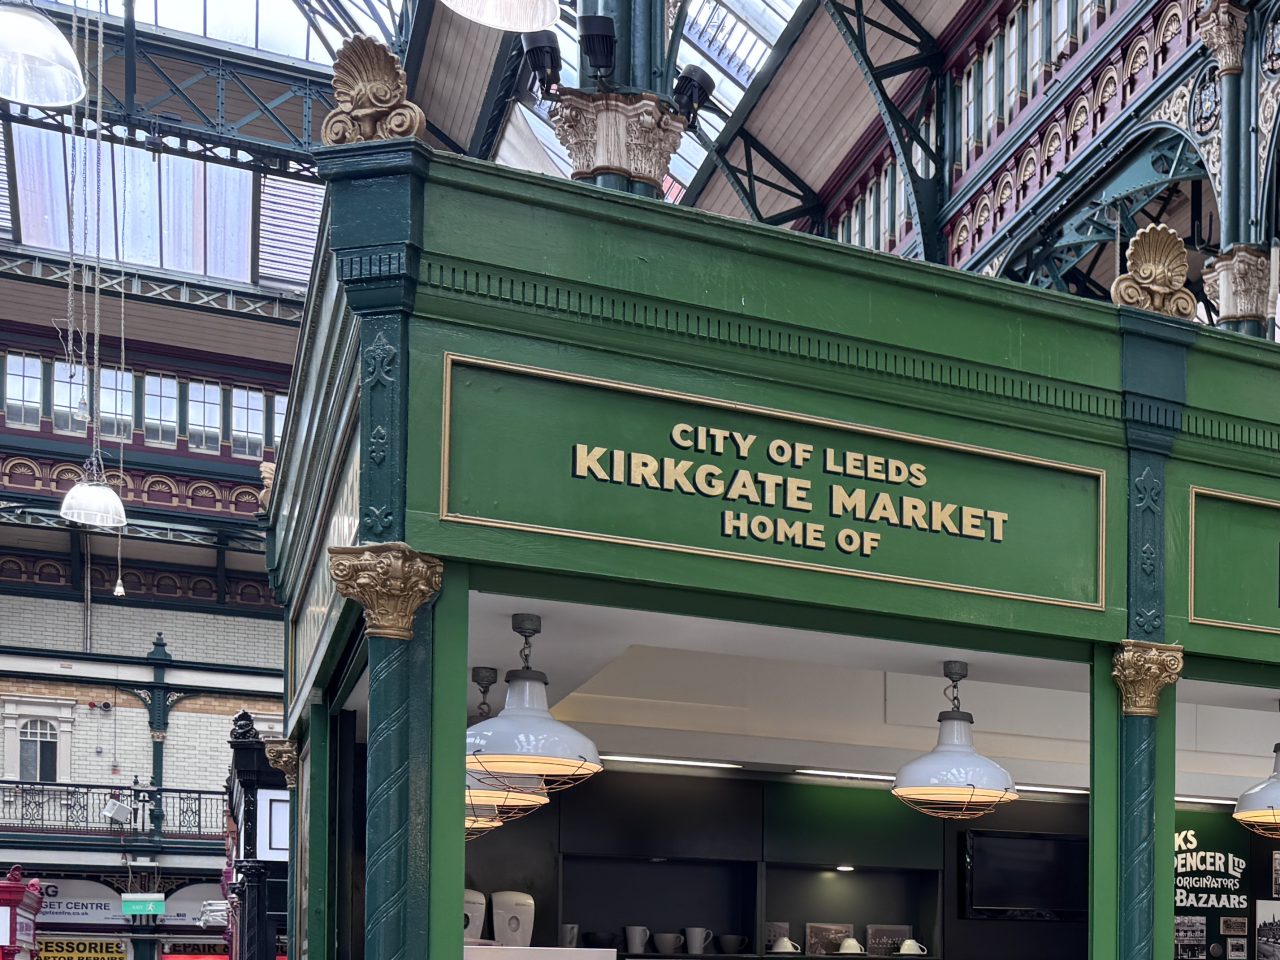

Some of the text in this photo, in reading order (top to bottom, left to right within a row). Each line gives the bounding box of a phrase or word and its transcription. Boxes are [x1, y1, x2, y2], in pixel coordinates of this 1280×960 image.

[671, 423, 928, 487] CITY OF LEEDS
[572, 443, 1009, 541] KIRKGATE MARKET
[722, 510, 881, 556] HOME OF
[1228, 853, 1246, 879] LTD
[1176, 875, 1240, 891] ORIGINATORS
[66, 901, 111, 910] CENTRE
[1175, 889, 1248, 909] BAZAARS
